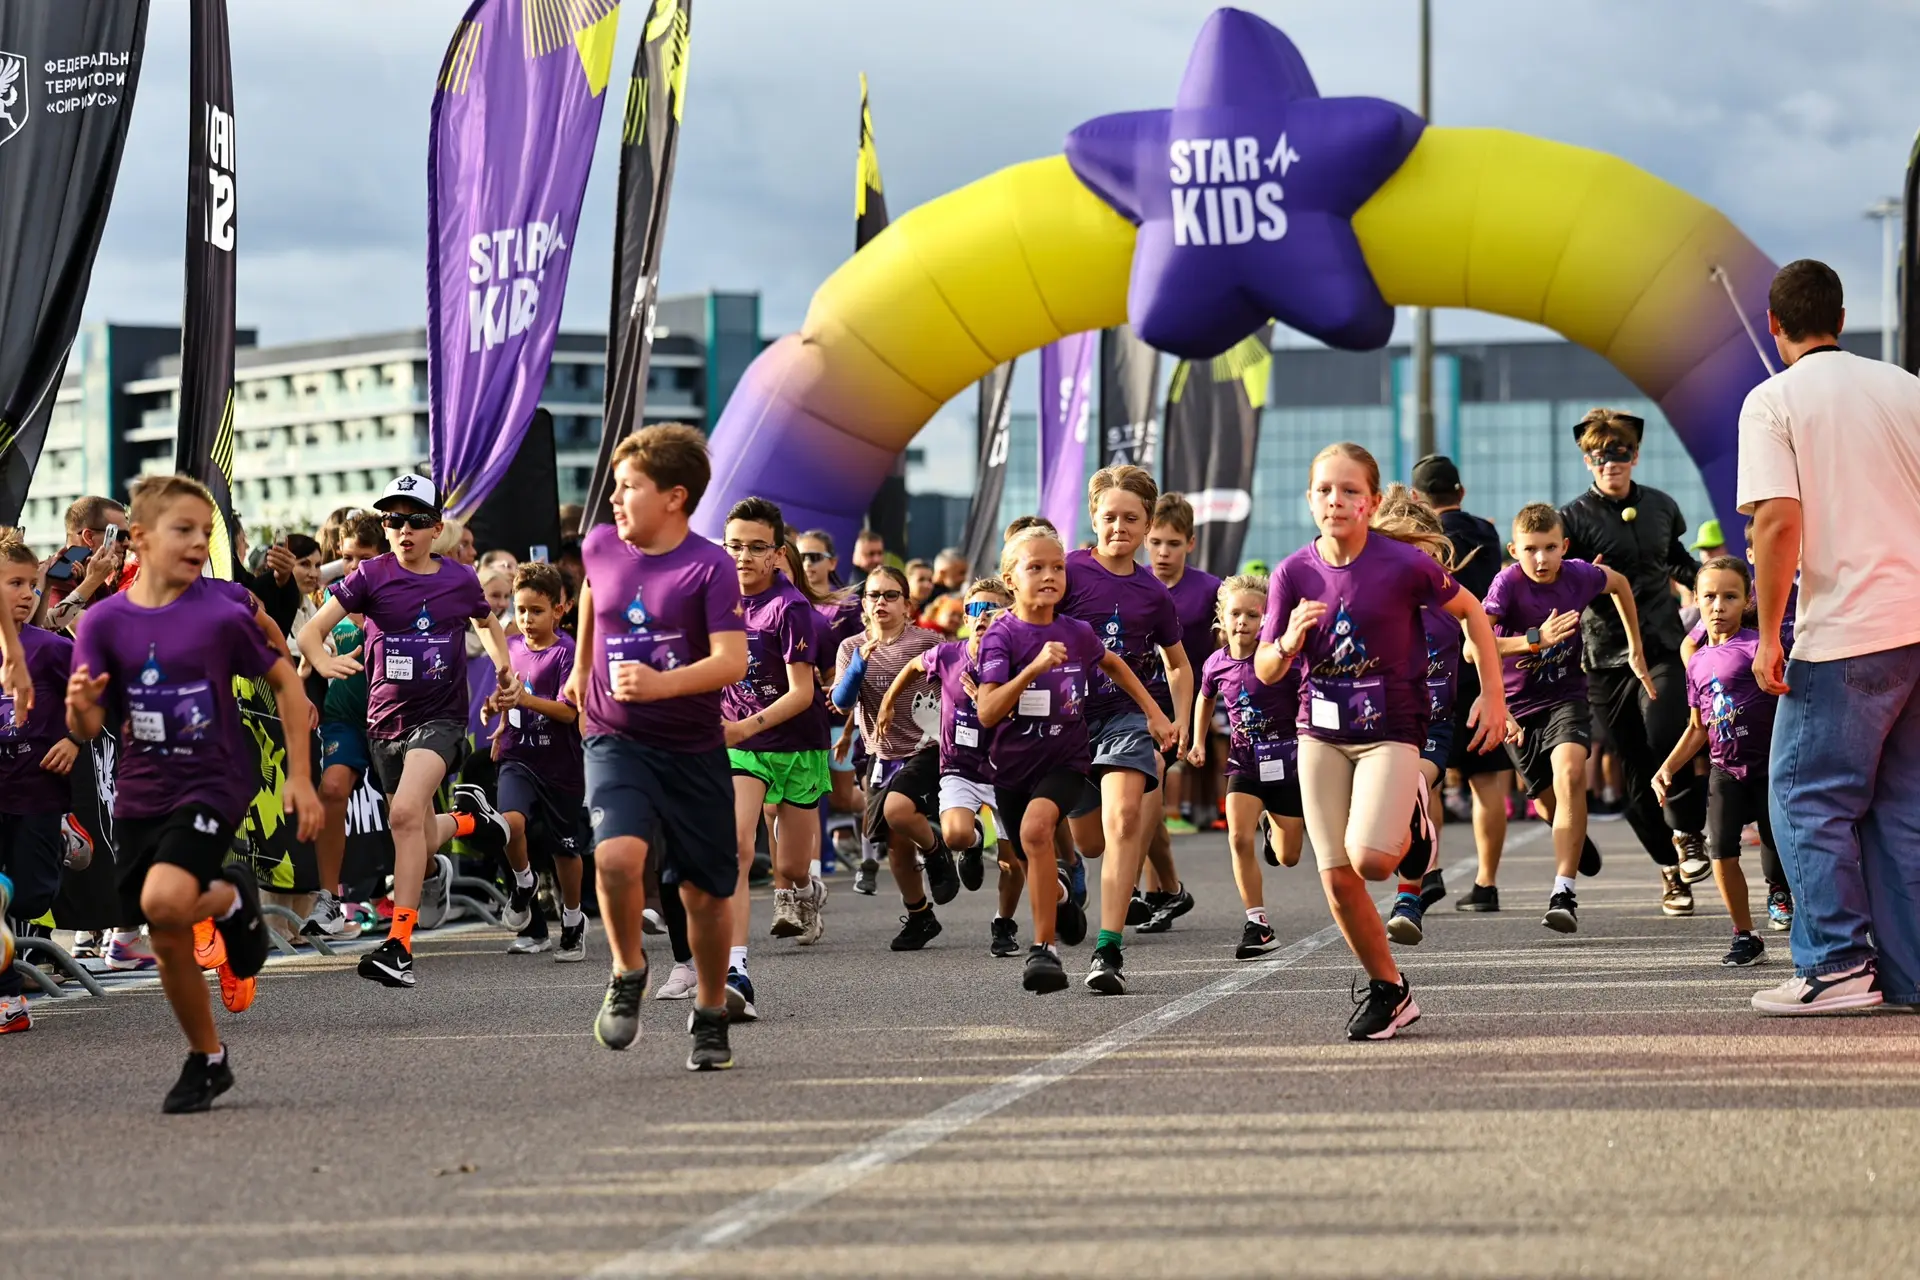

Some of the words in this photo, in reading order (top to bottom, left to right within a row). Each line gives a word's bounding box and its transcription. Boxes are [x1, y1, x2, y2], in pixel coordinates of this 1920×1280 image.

[46, 92, 118, 115] «СИРИУС»
[1169, 135, 1261, 186] STAR
[1170, 181, 1288, 246] KIDS
